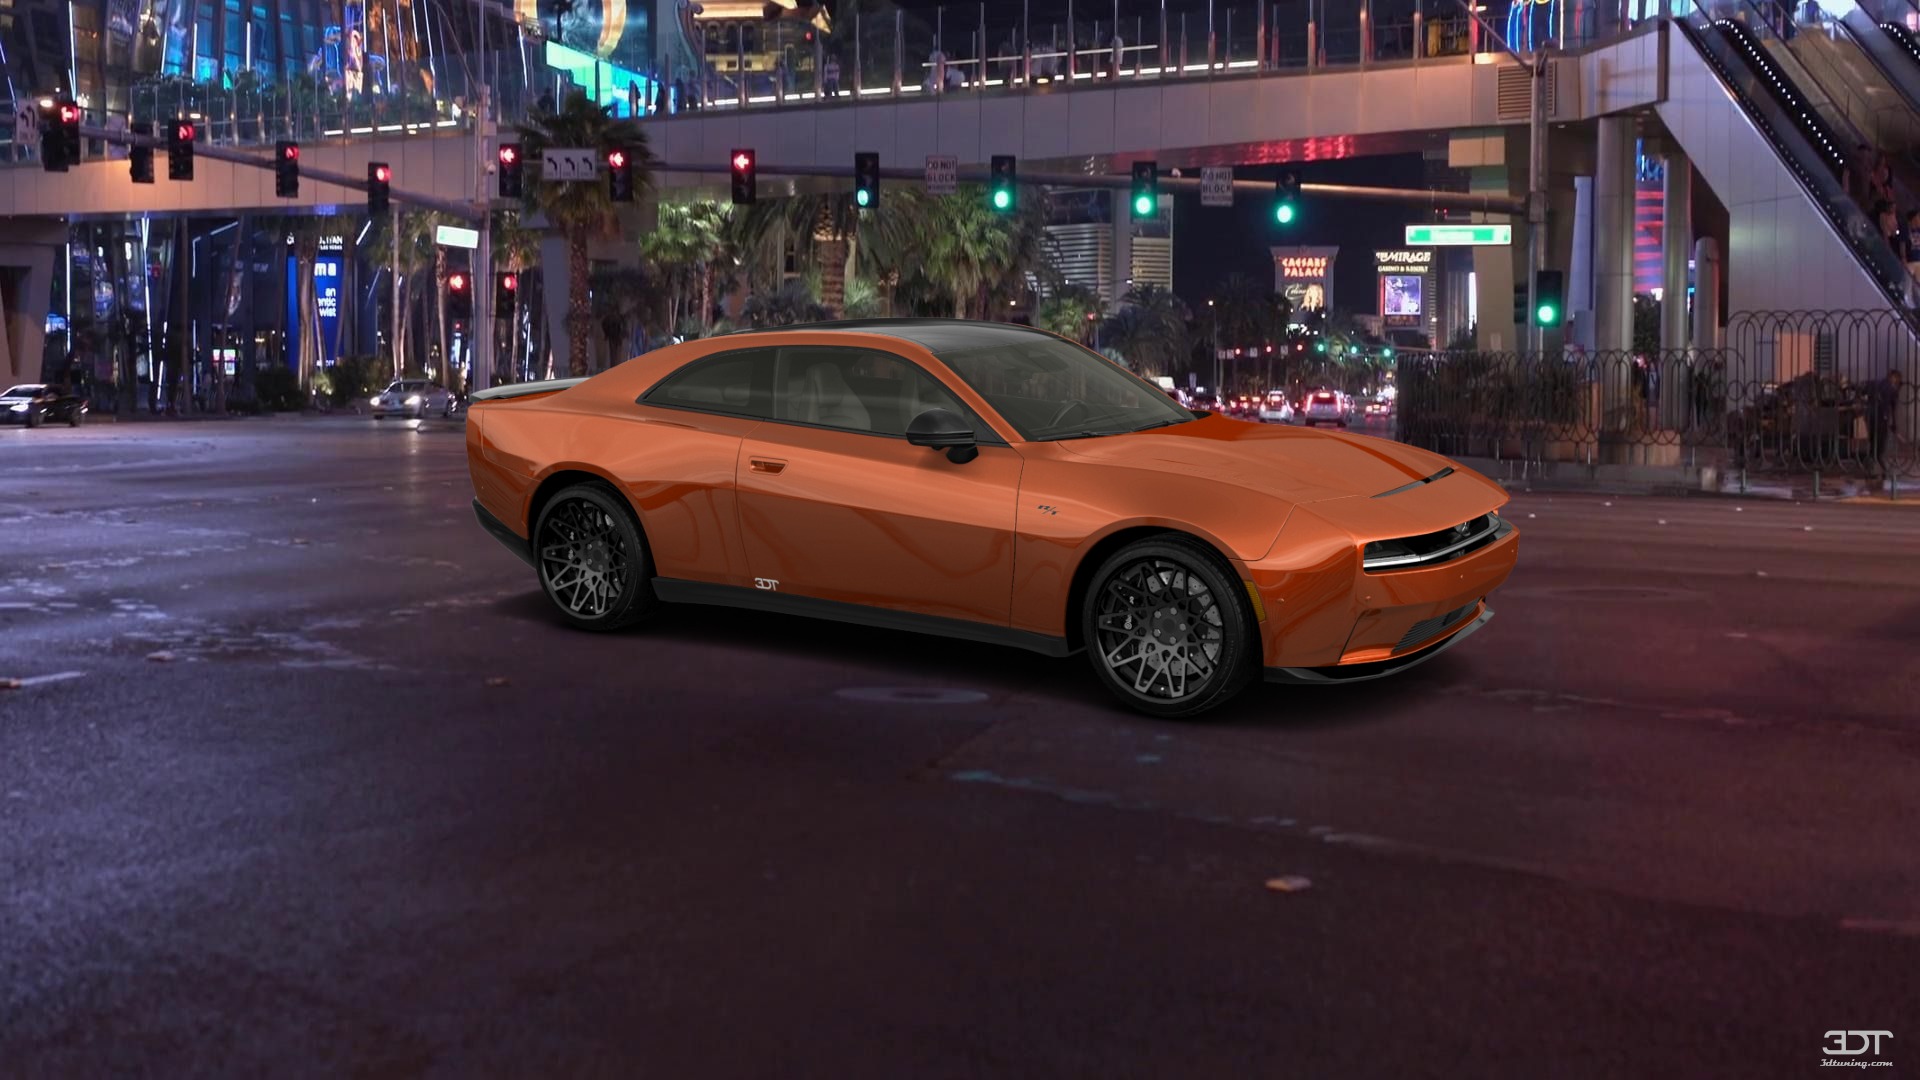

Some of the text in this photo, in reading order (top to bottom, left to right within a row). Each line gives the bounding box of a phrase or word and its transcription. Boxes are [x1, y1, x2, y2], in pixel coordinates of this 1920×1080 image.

[1282, 257, 1327, 268] CAESARS
[1381, 252, 1431, 263] MIRAGE
[1284, 267, 1324, 277] PALACE
[755, 577, 779, 591] 3DT
